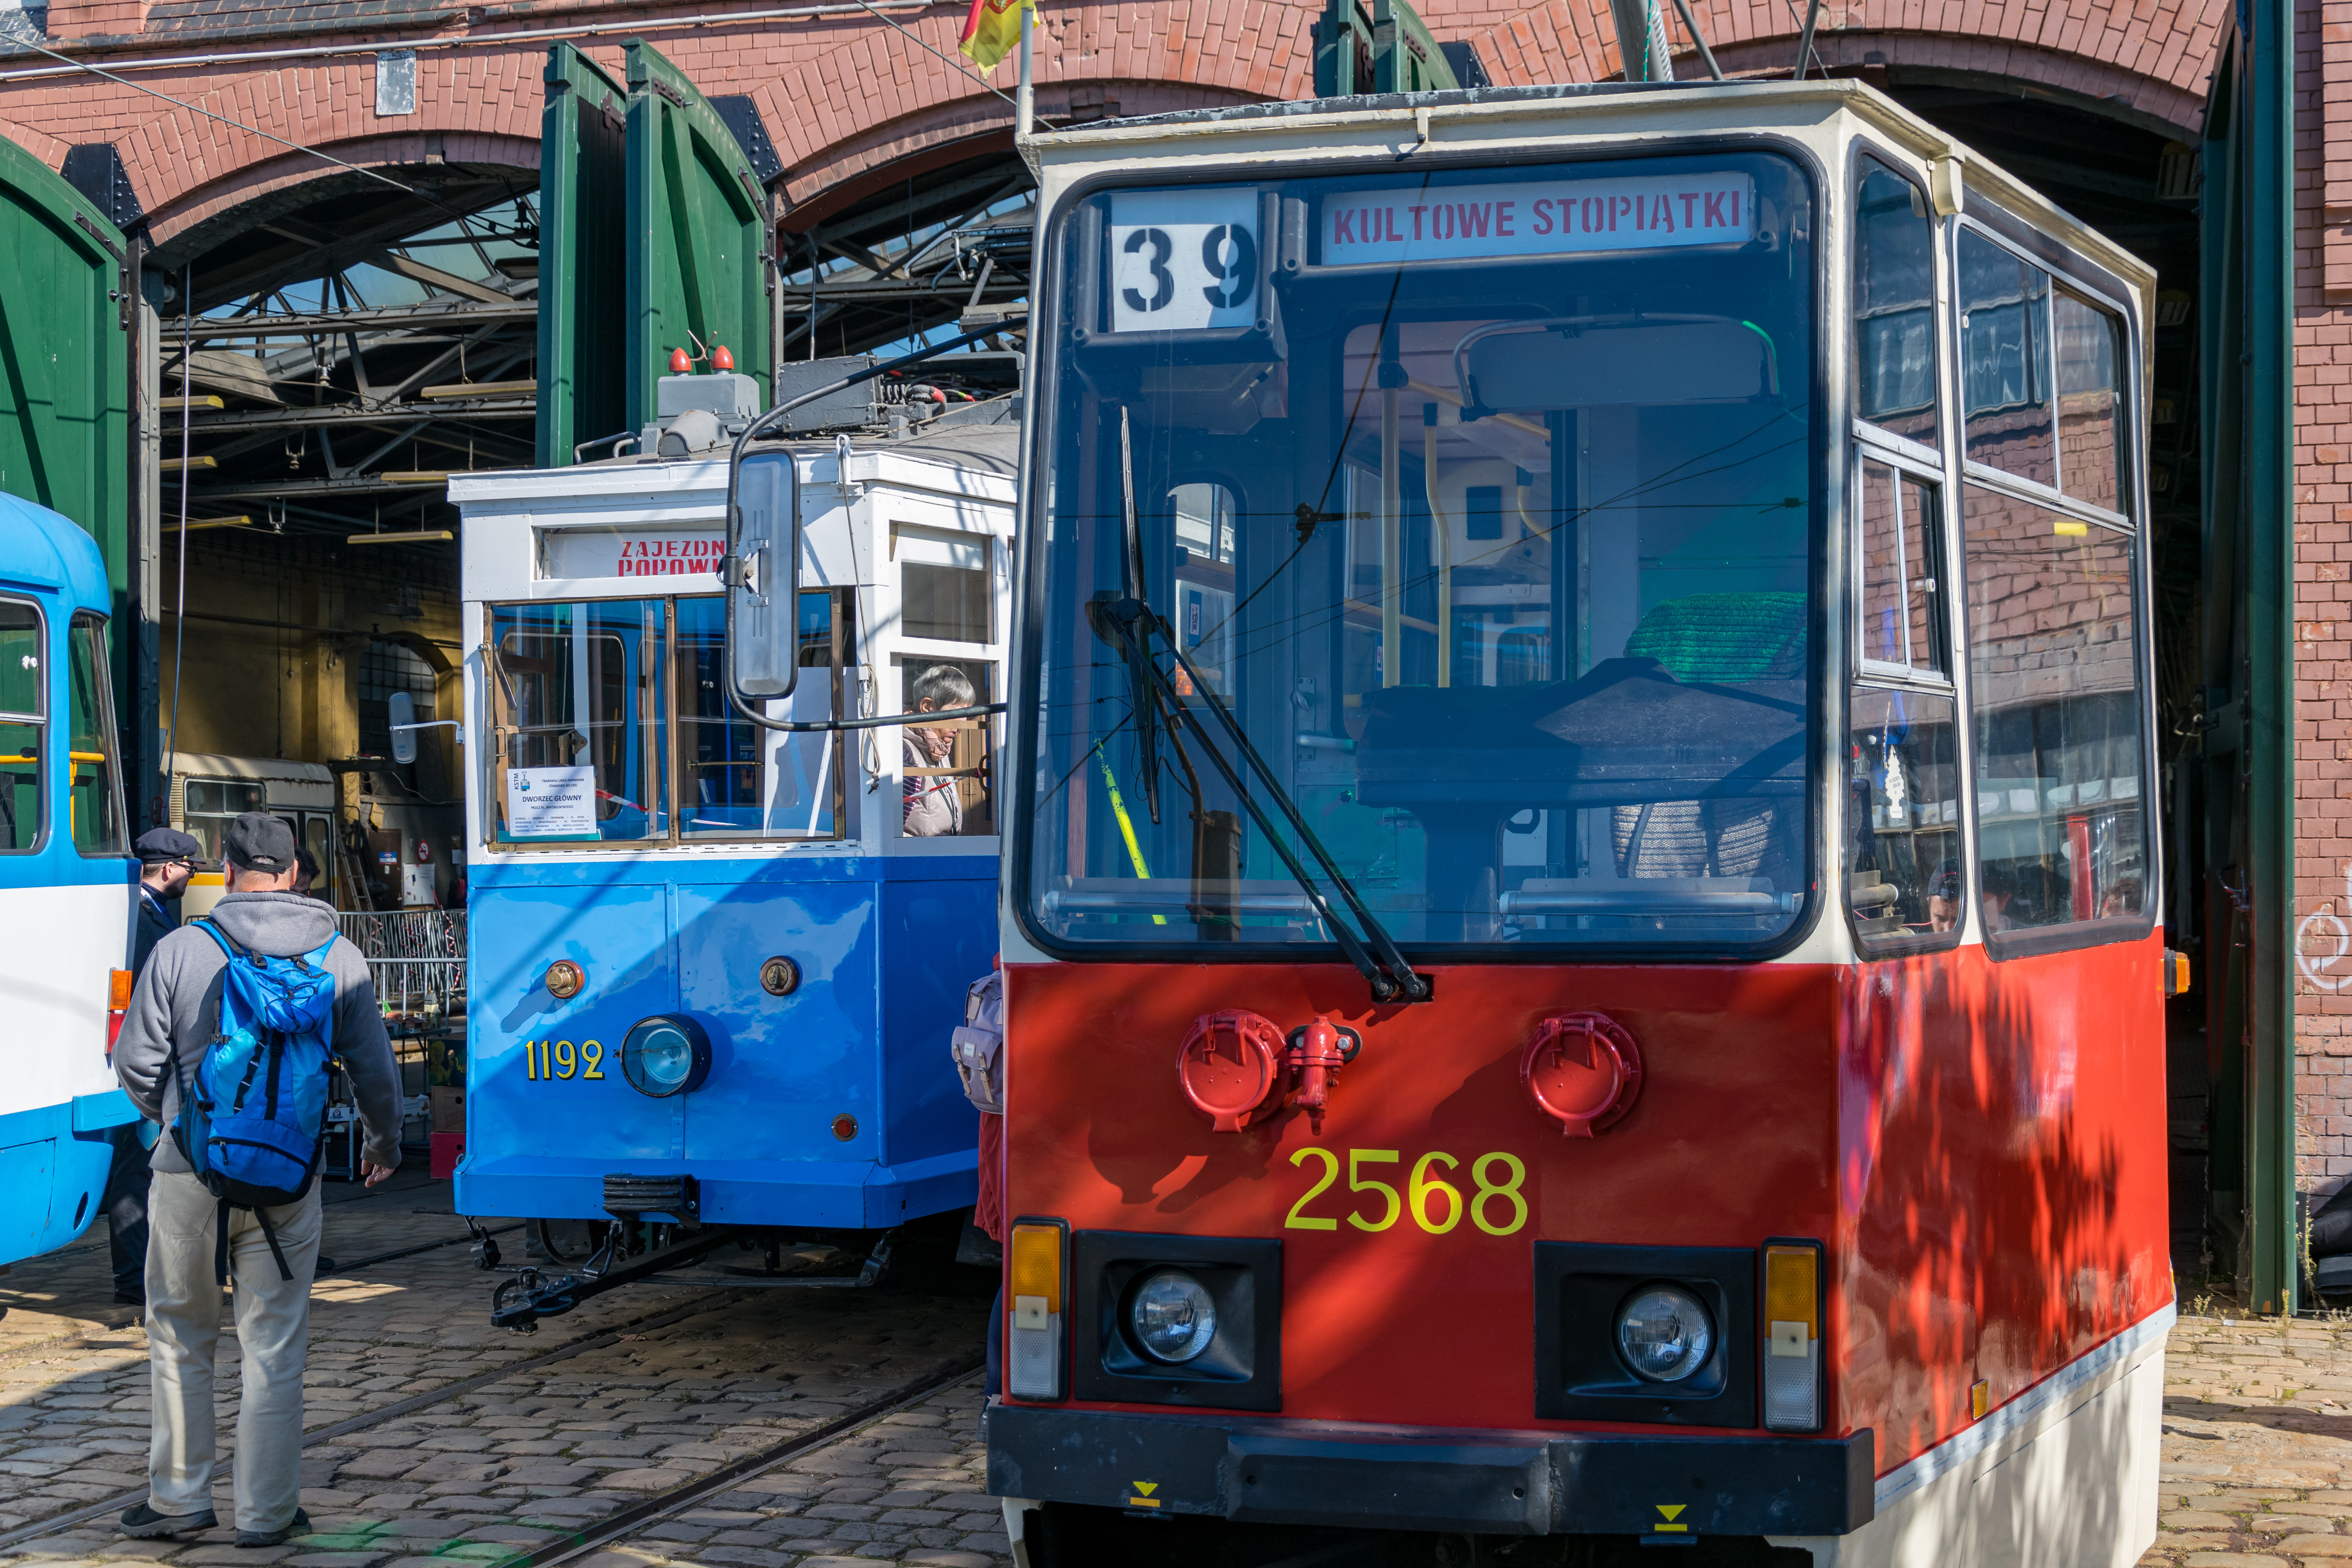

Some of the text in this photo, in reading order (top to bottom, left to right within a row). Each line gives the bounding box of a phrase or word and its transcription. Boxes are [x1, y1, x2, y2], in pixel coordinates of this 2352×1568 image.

[1334, 190, 1739, 245] KULTOWE STOPIĄTKI
[618, 558, 720, 577] POPOWI
[621, 540, 725, 557] ZAJEZDN
[525, 1039, 605, 1081] 1192
[1284, 1147, 1528, 1236] 2568
